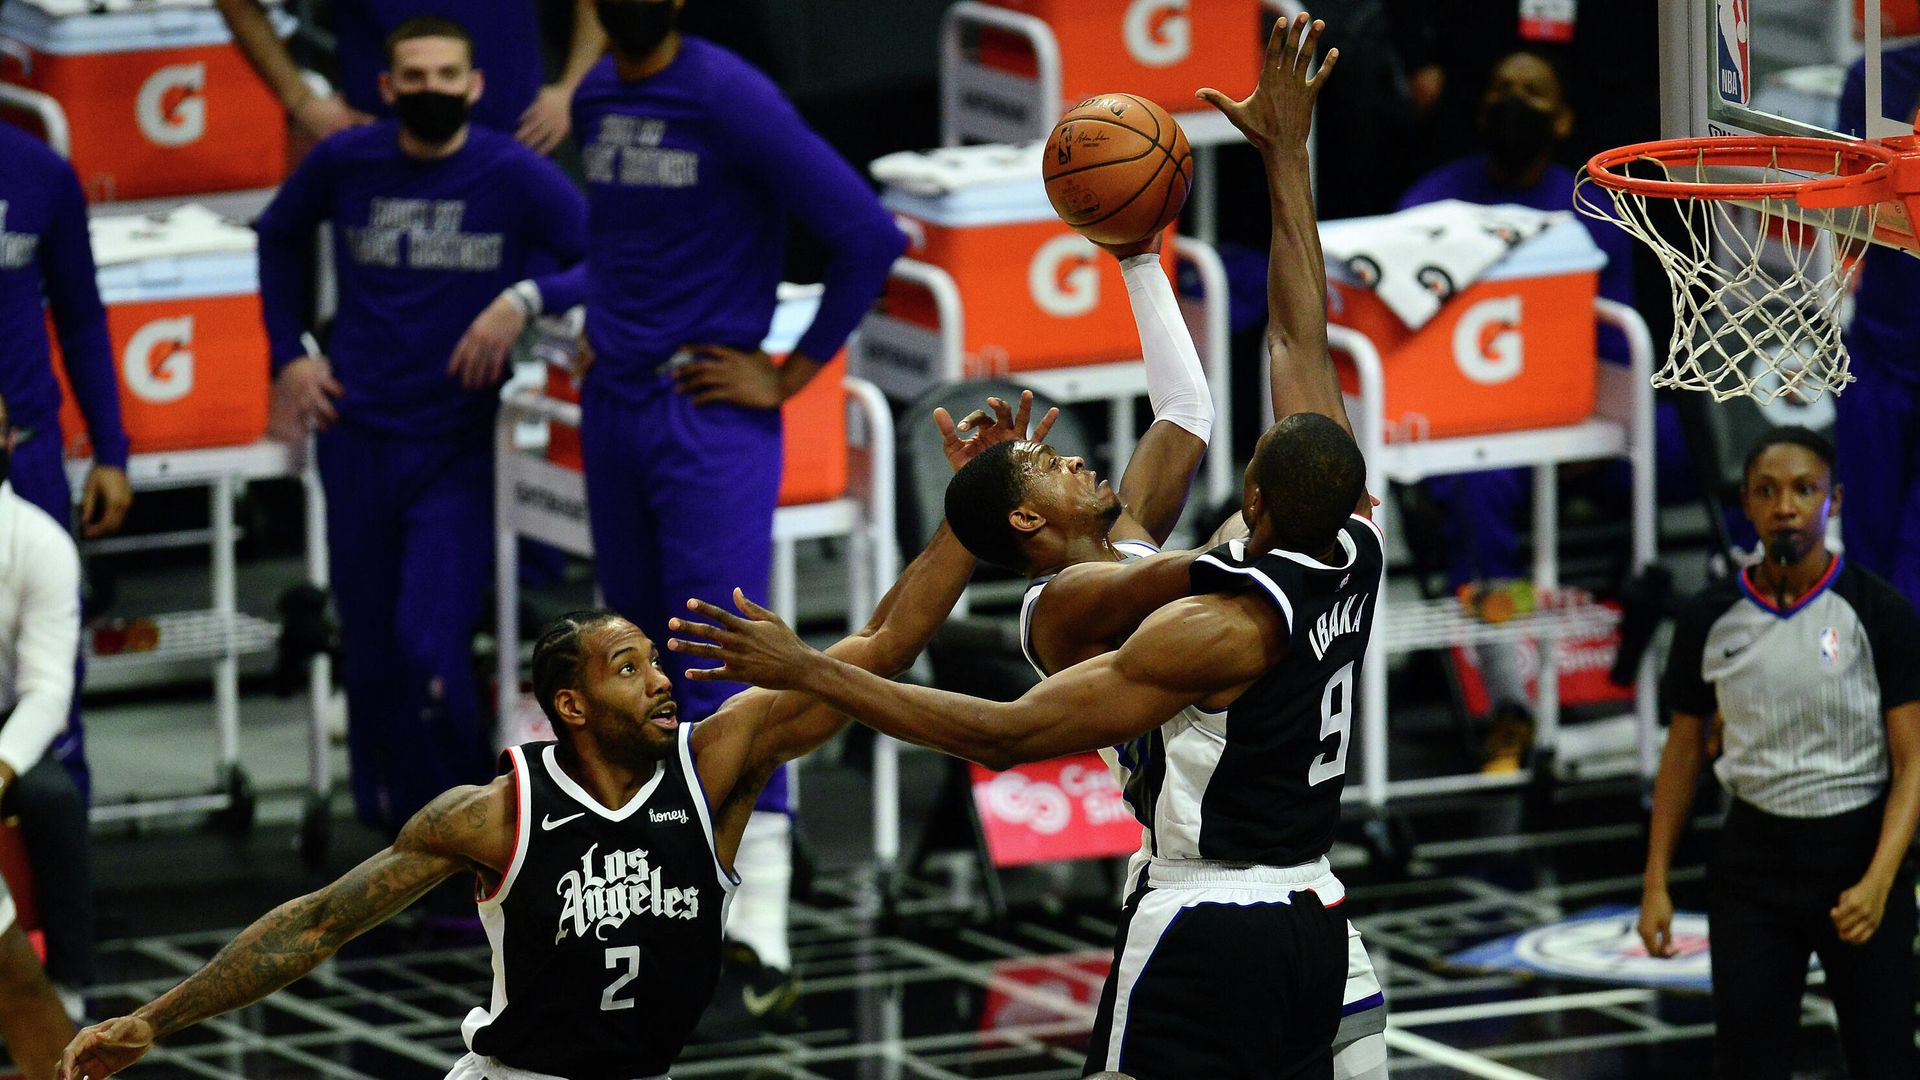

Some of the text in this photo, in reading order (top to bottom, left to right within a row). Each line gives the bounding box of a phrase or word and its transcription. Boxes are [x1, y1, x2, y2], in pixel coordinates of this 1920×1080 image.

[1124, 0, 1191, 66] G
[137, 61, 206, 146] G
[1721, 68, 1738, 96] NBA
[1028, 233, 1099, 317] G
[124, 316, 194, 402] G
[1453, 295, 1523, 384] G
[1308, 592, 1369, 661] IBAKA
[1308, 660, 1355, 787] 9
[649, 808, 689, 824] honey
[580, 842, 650, 891] Los
[555, 866, 700, 946] Angeles
[600, 945, 640, 1011] 2
